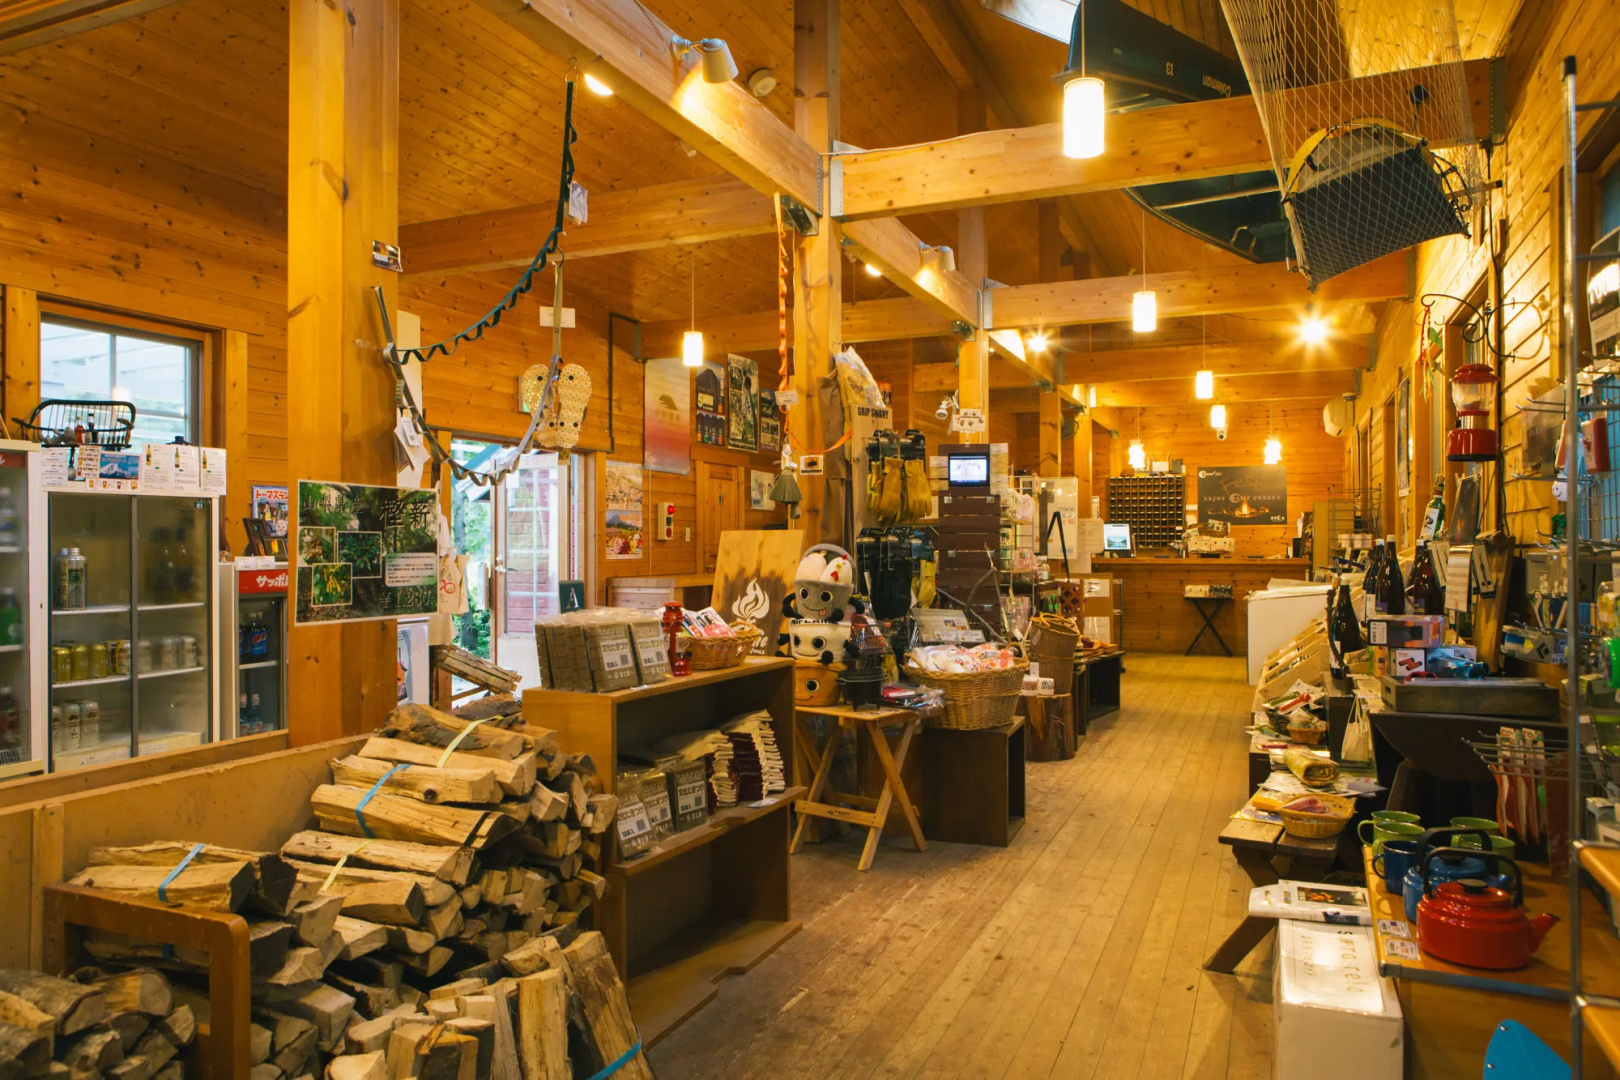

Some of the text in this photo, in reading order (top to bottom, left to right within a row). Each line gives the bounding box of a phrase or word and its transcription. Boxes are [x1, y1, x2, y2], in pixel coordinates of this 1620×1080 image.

[1202, 74, 1232, 98] Coleman
[857, 406, 889, 420] GRIP SWANY
[303, 493, 363, 514] 山梨県産
[1203, 495, 1226, 503] ENJOY
